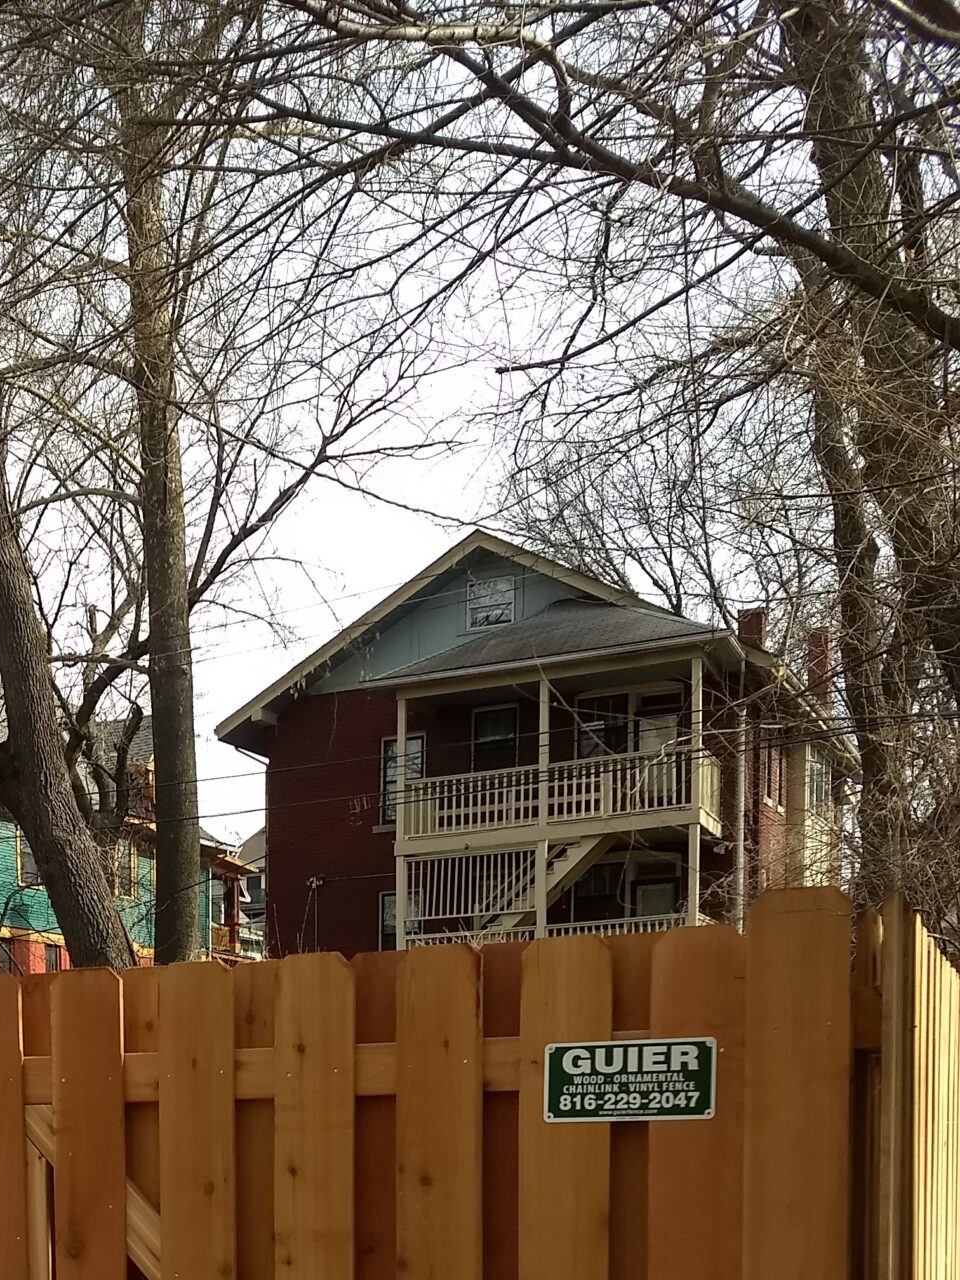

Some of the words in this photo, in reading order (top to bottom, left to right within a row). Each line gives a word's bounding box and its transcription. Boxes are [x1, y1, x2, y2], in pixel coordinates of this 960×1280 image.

[562, 1044, 700, 1075] GUIER
[573, 1075, 605, 1085] WOOD
[613, 1072, 685, 1083] ORNAMENTAL
[563, 1083, 620, 1094] CHAINLINK
[628, 1082, 661, 1092] VINYL
[662, 1081, 696, 1091] FENCE
[559, 1091, 701, 1111] 816-229-2047
[598, 1108, 658, 1116] www.guierfence.com
